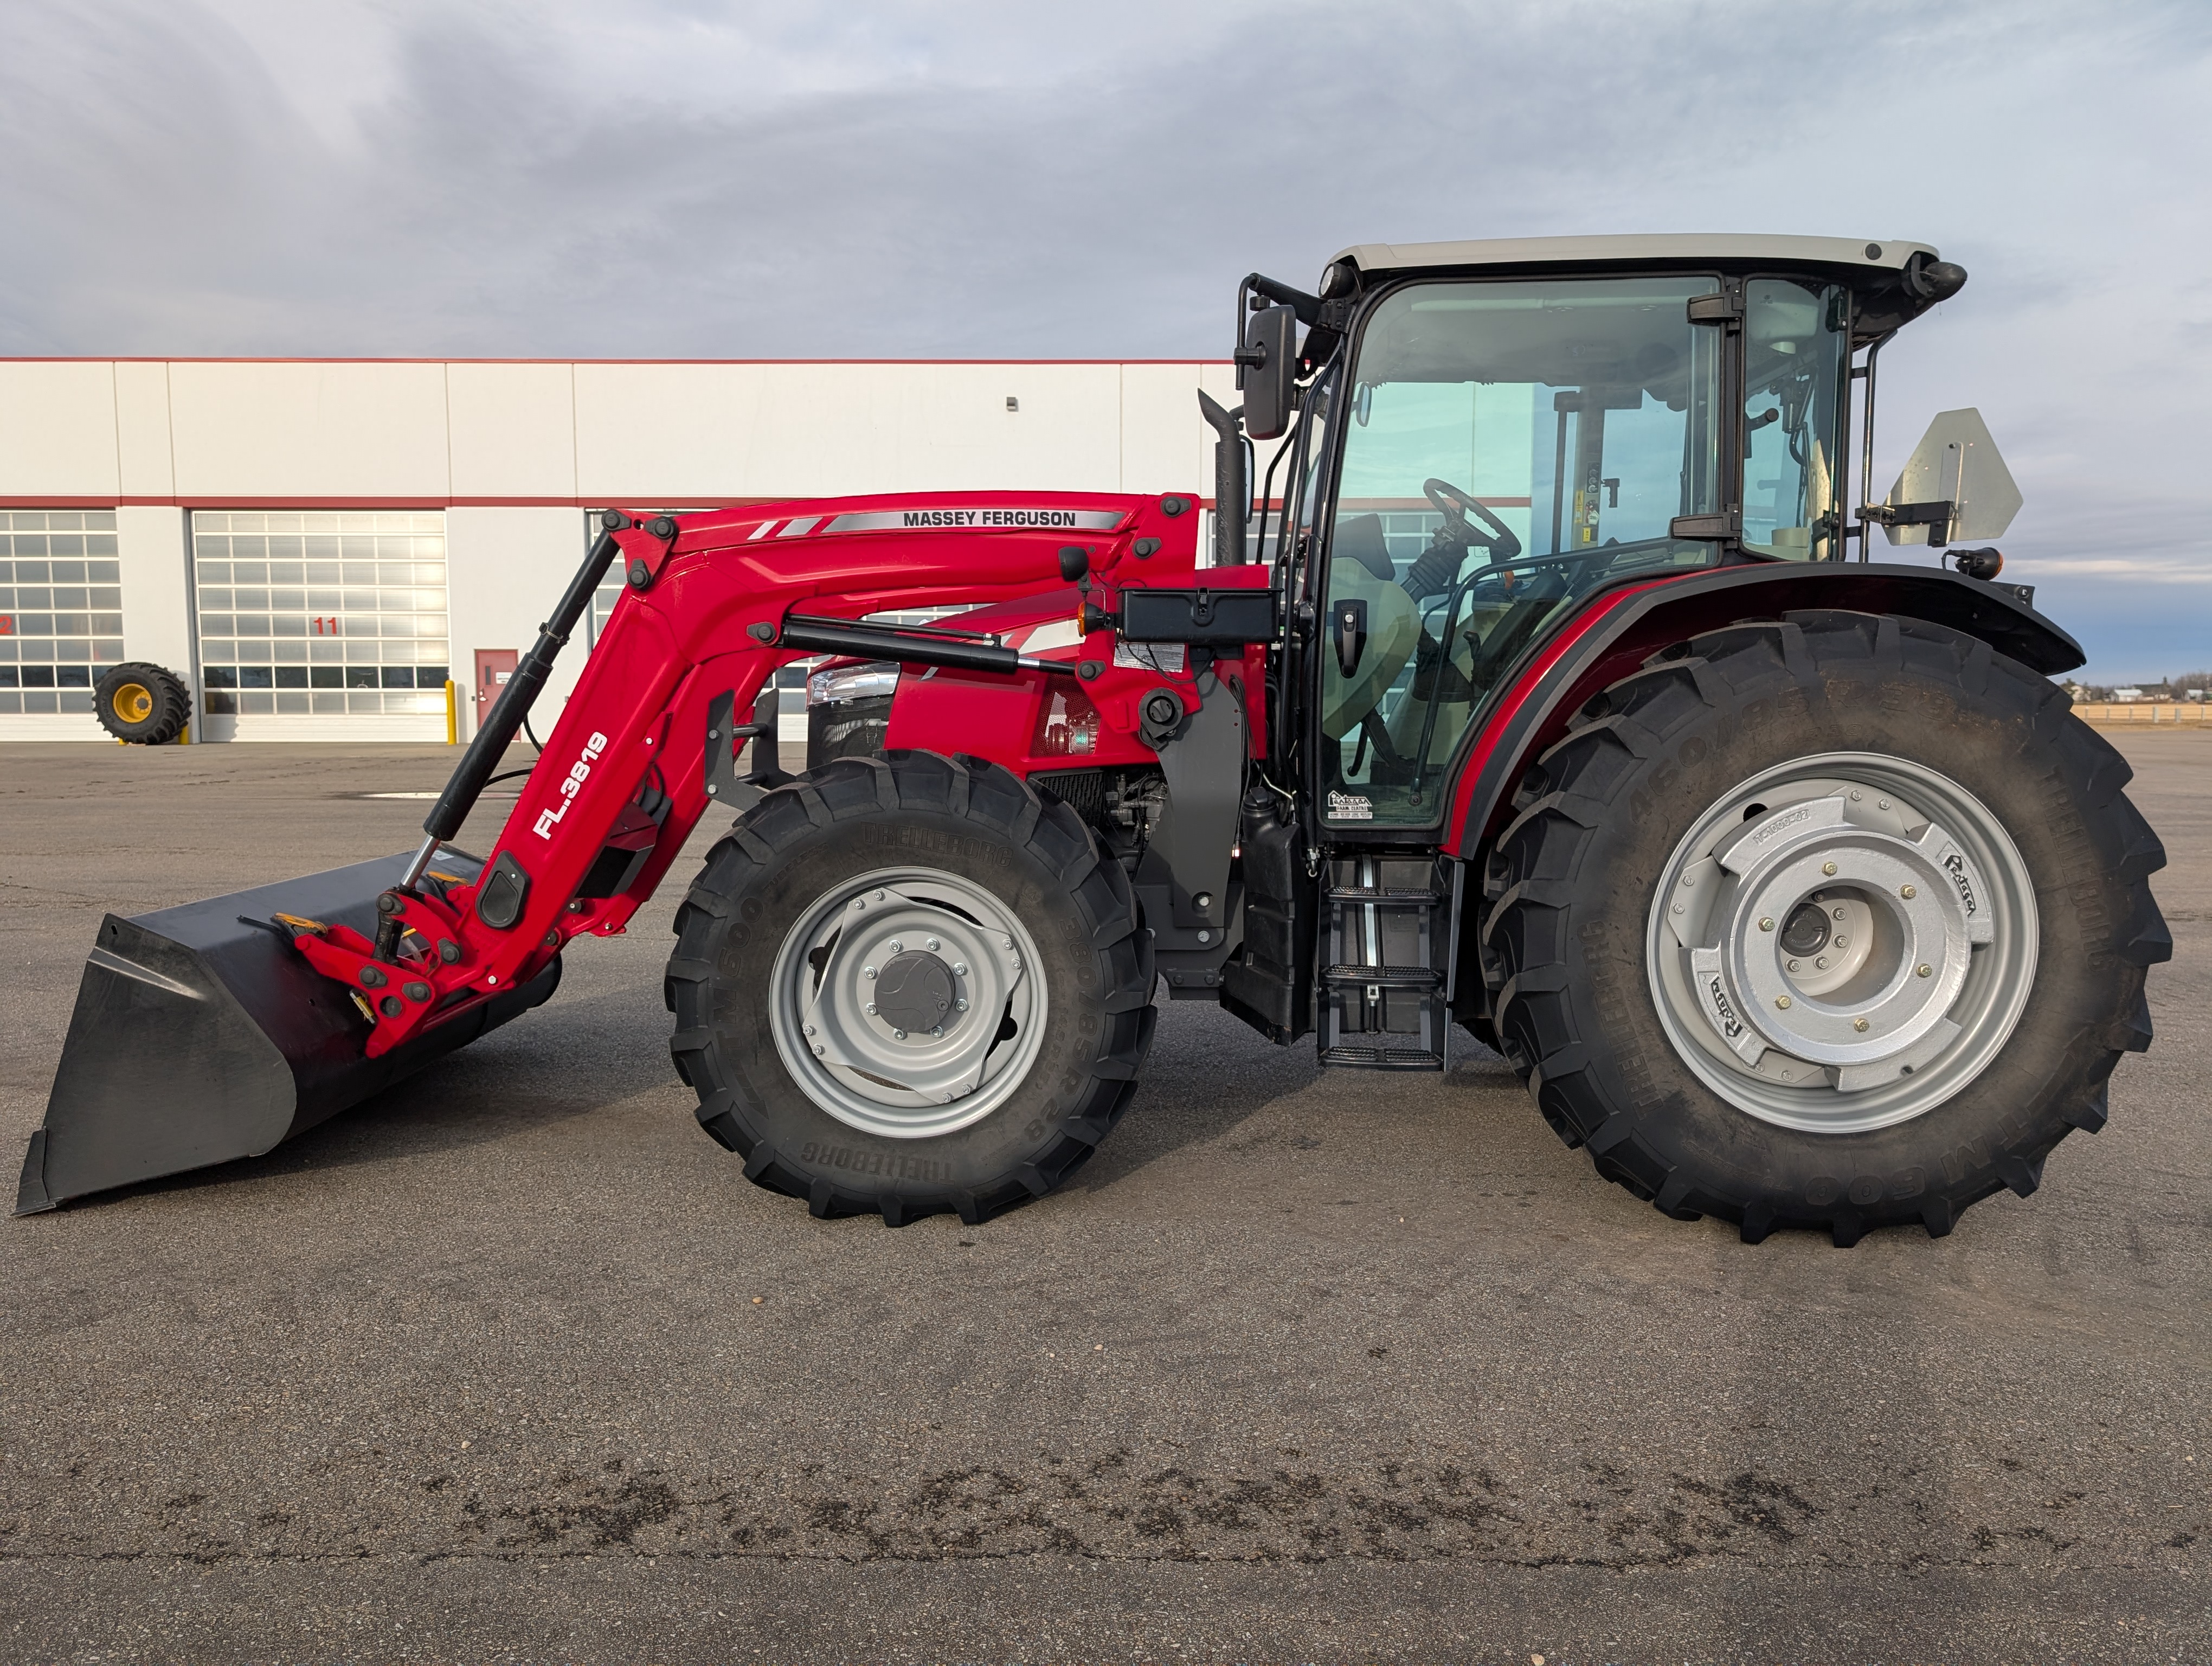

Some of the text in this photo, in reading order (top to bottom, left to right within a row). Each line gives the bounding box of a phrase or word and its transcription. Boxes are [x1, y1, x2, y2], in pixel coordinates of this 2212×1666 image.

[904, 511, 1076, 527] MASSEY FERGUSON
[313, 617, 337, 634] 11
[1628, 687, 1810, 823] 460/85
[532, 732, 608, 840] FL.3819
[1329, 791, 1371, 805] Pentagon
[859, 821, 1015, 867] TRELLEBORG
[1755, 810, 1809, 843] T-1000-02
[763, 842, 829, 895] TUBELESS
[1944, 855, 1976, 917] Pentagon
[2039, 765, 2115, 971] TRELLEBORG
[716, 892, 767, 978] 600
[1021, 913, 1098, 1145] 380/85 R 28
[1577, 920, 1664, 1120] TRELLEBORG
[1711, 976, 1743, 1037] Pentagon
[799, 1140, 956, 1185] TRELLEBORG
[1681, 1138, 1791, 1193] TUBELESS
[1805, 1166, 1927, 1205] 600
